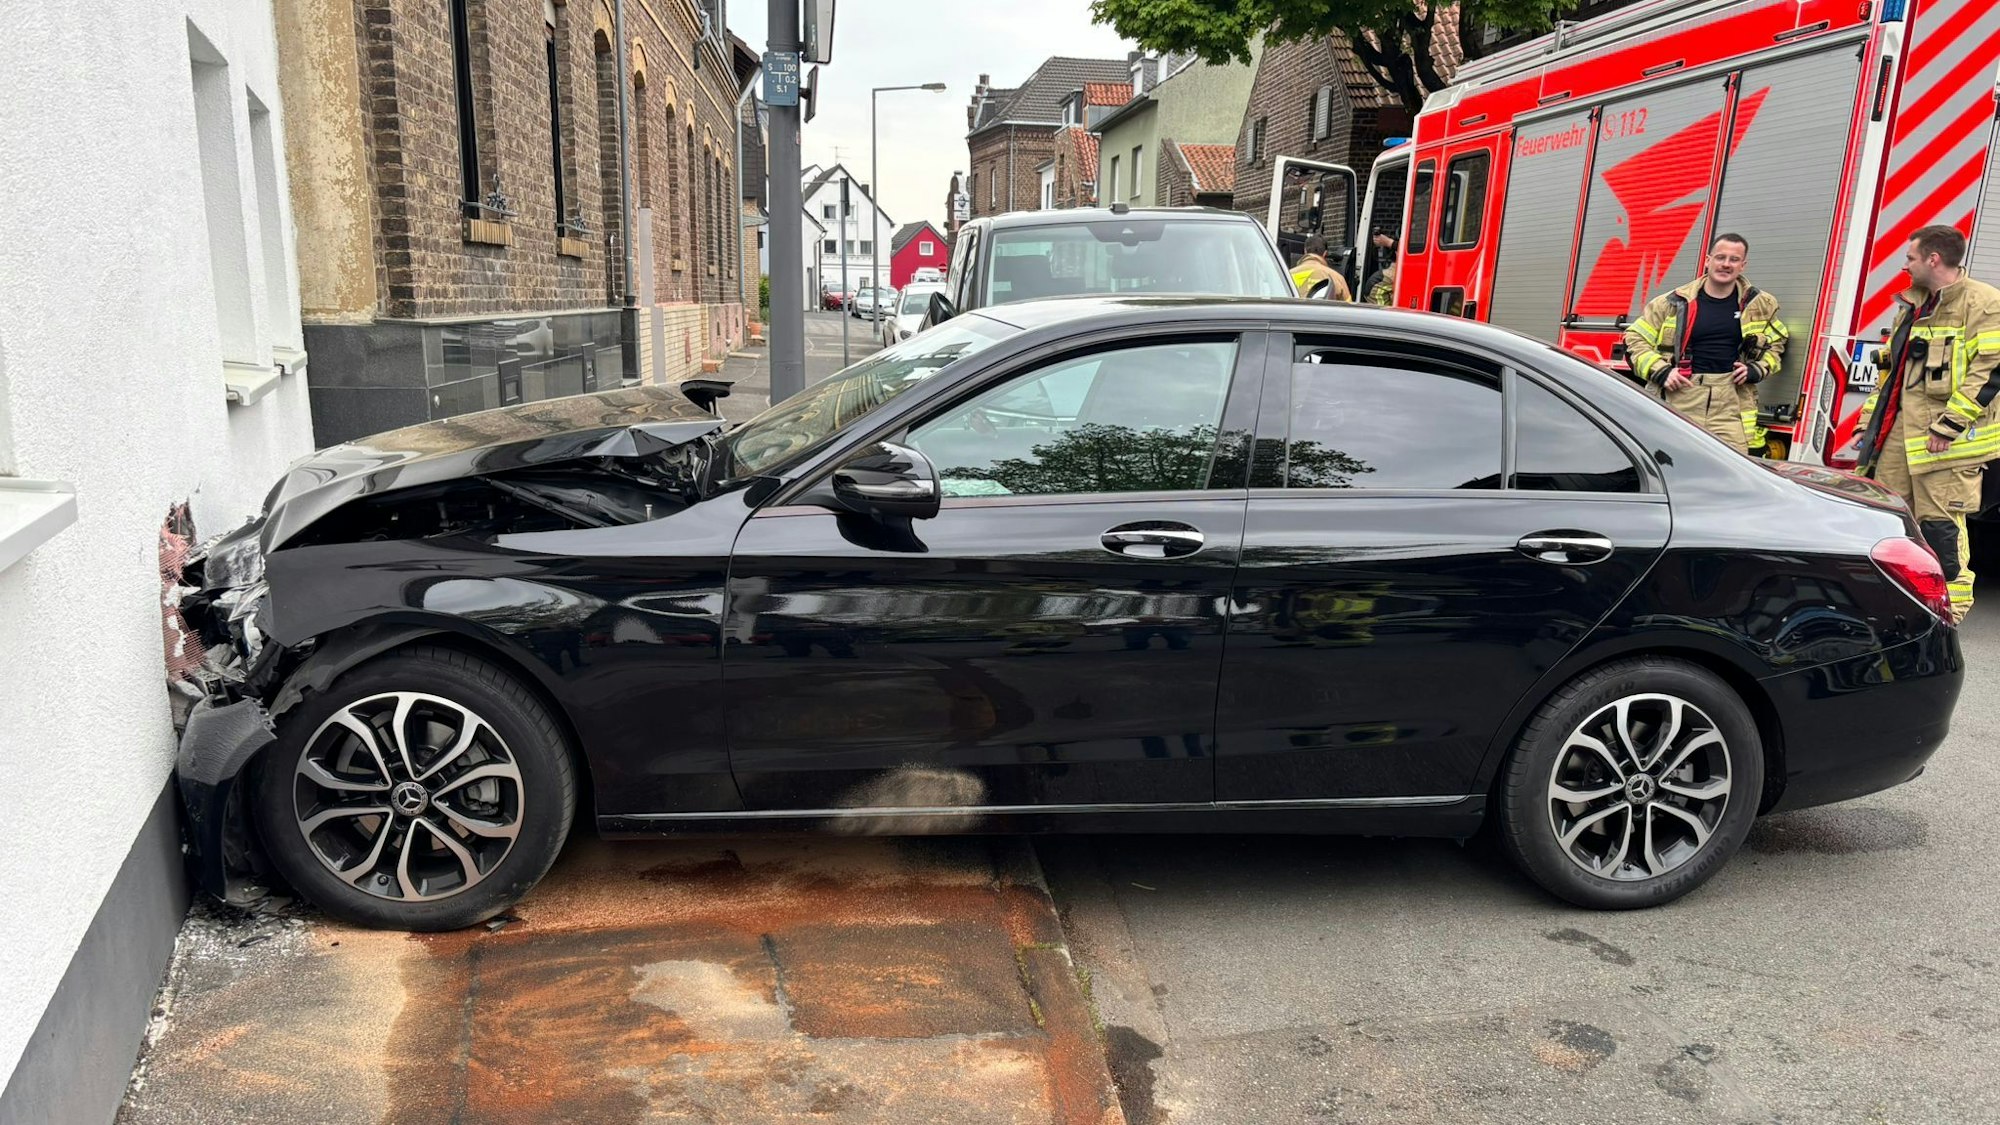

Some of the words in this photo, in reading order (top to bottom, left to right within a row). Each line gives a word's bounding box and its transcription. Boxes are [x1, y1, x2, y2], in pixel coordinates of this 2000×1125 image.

[768, 63, 773, 71] S
[783, 64, 797, 72] 100
[785, 76, 797, 84] 0.2
[776, 85, 788, 93] 5.1
[1620, 107, 1648, 137] 112
[1515, 122, 1586, 157] Feuerwehr
[1852, 364, 1873, 382] LN
